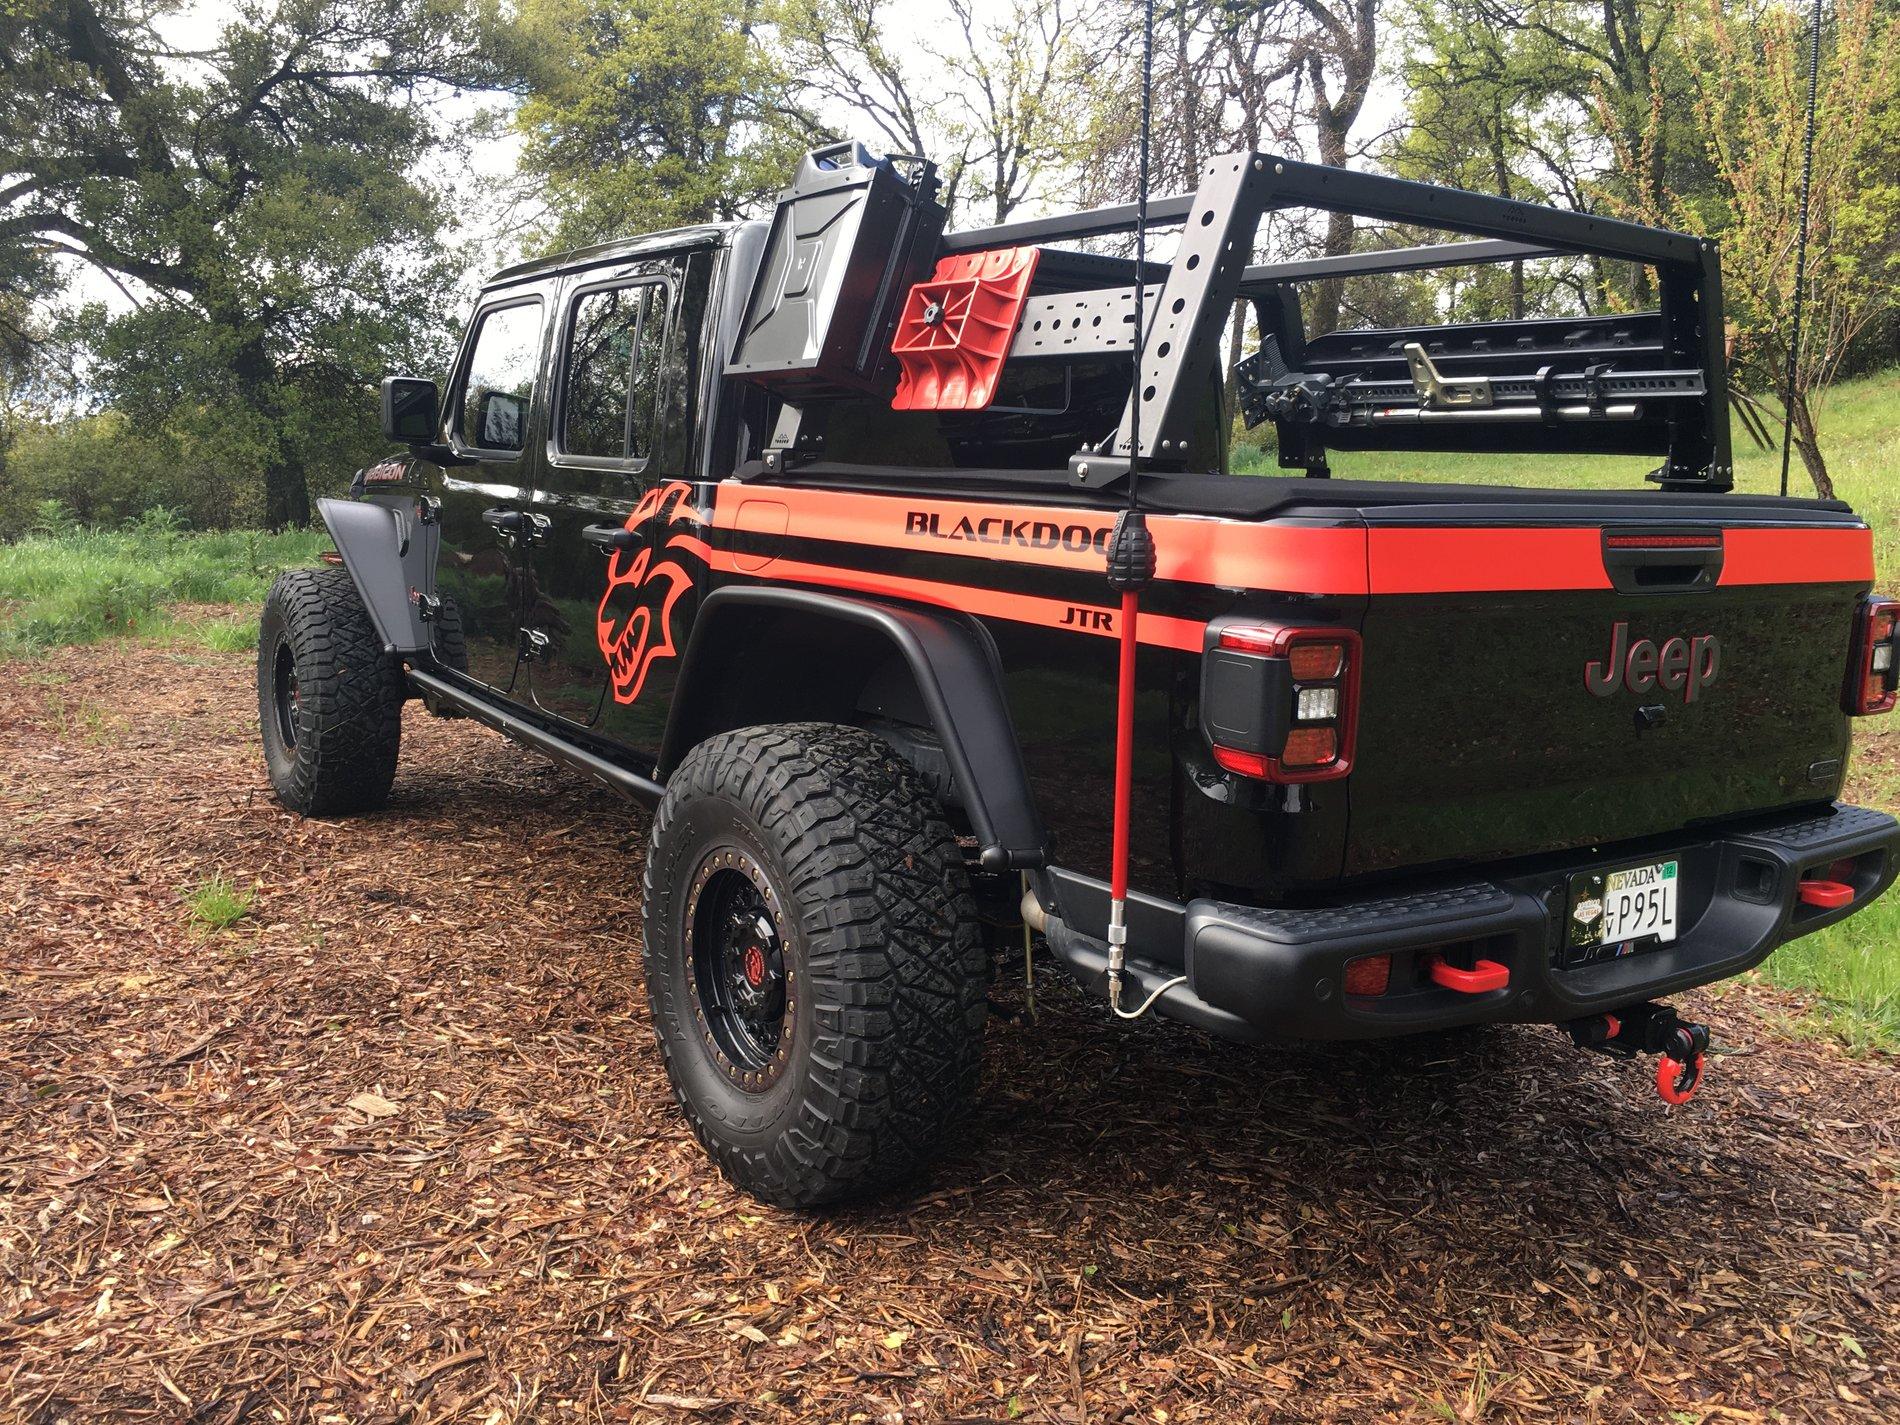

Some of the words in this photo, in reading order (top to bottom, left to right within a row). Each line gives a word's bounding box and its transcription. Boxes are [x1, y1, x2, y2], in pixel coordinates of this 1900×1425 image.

[1059, 607, 1113, 632] JTR
[1584, 621, 1721, 704] Jeep
[1605, 867, 1656, 892] NEVADA
